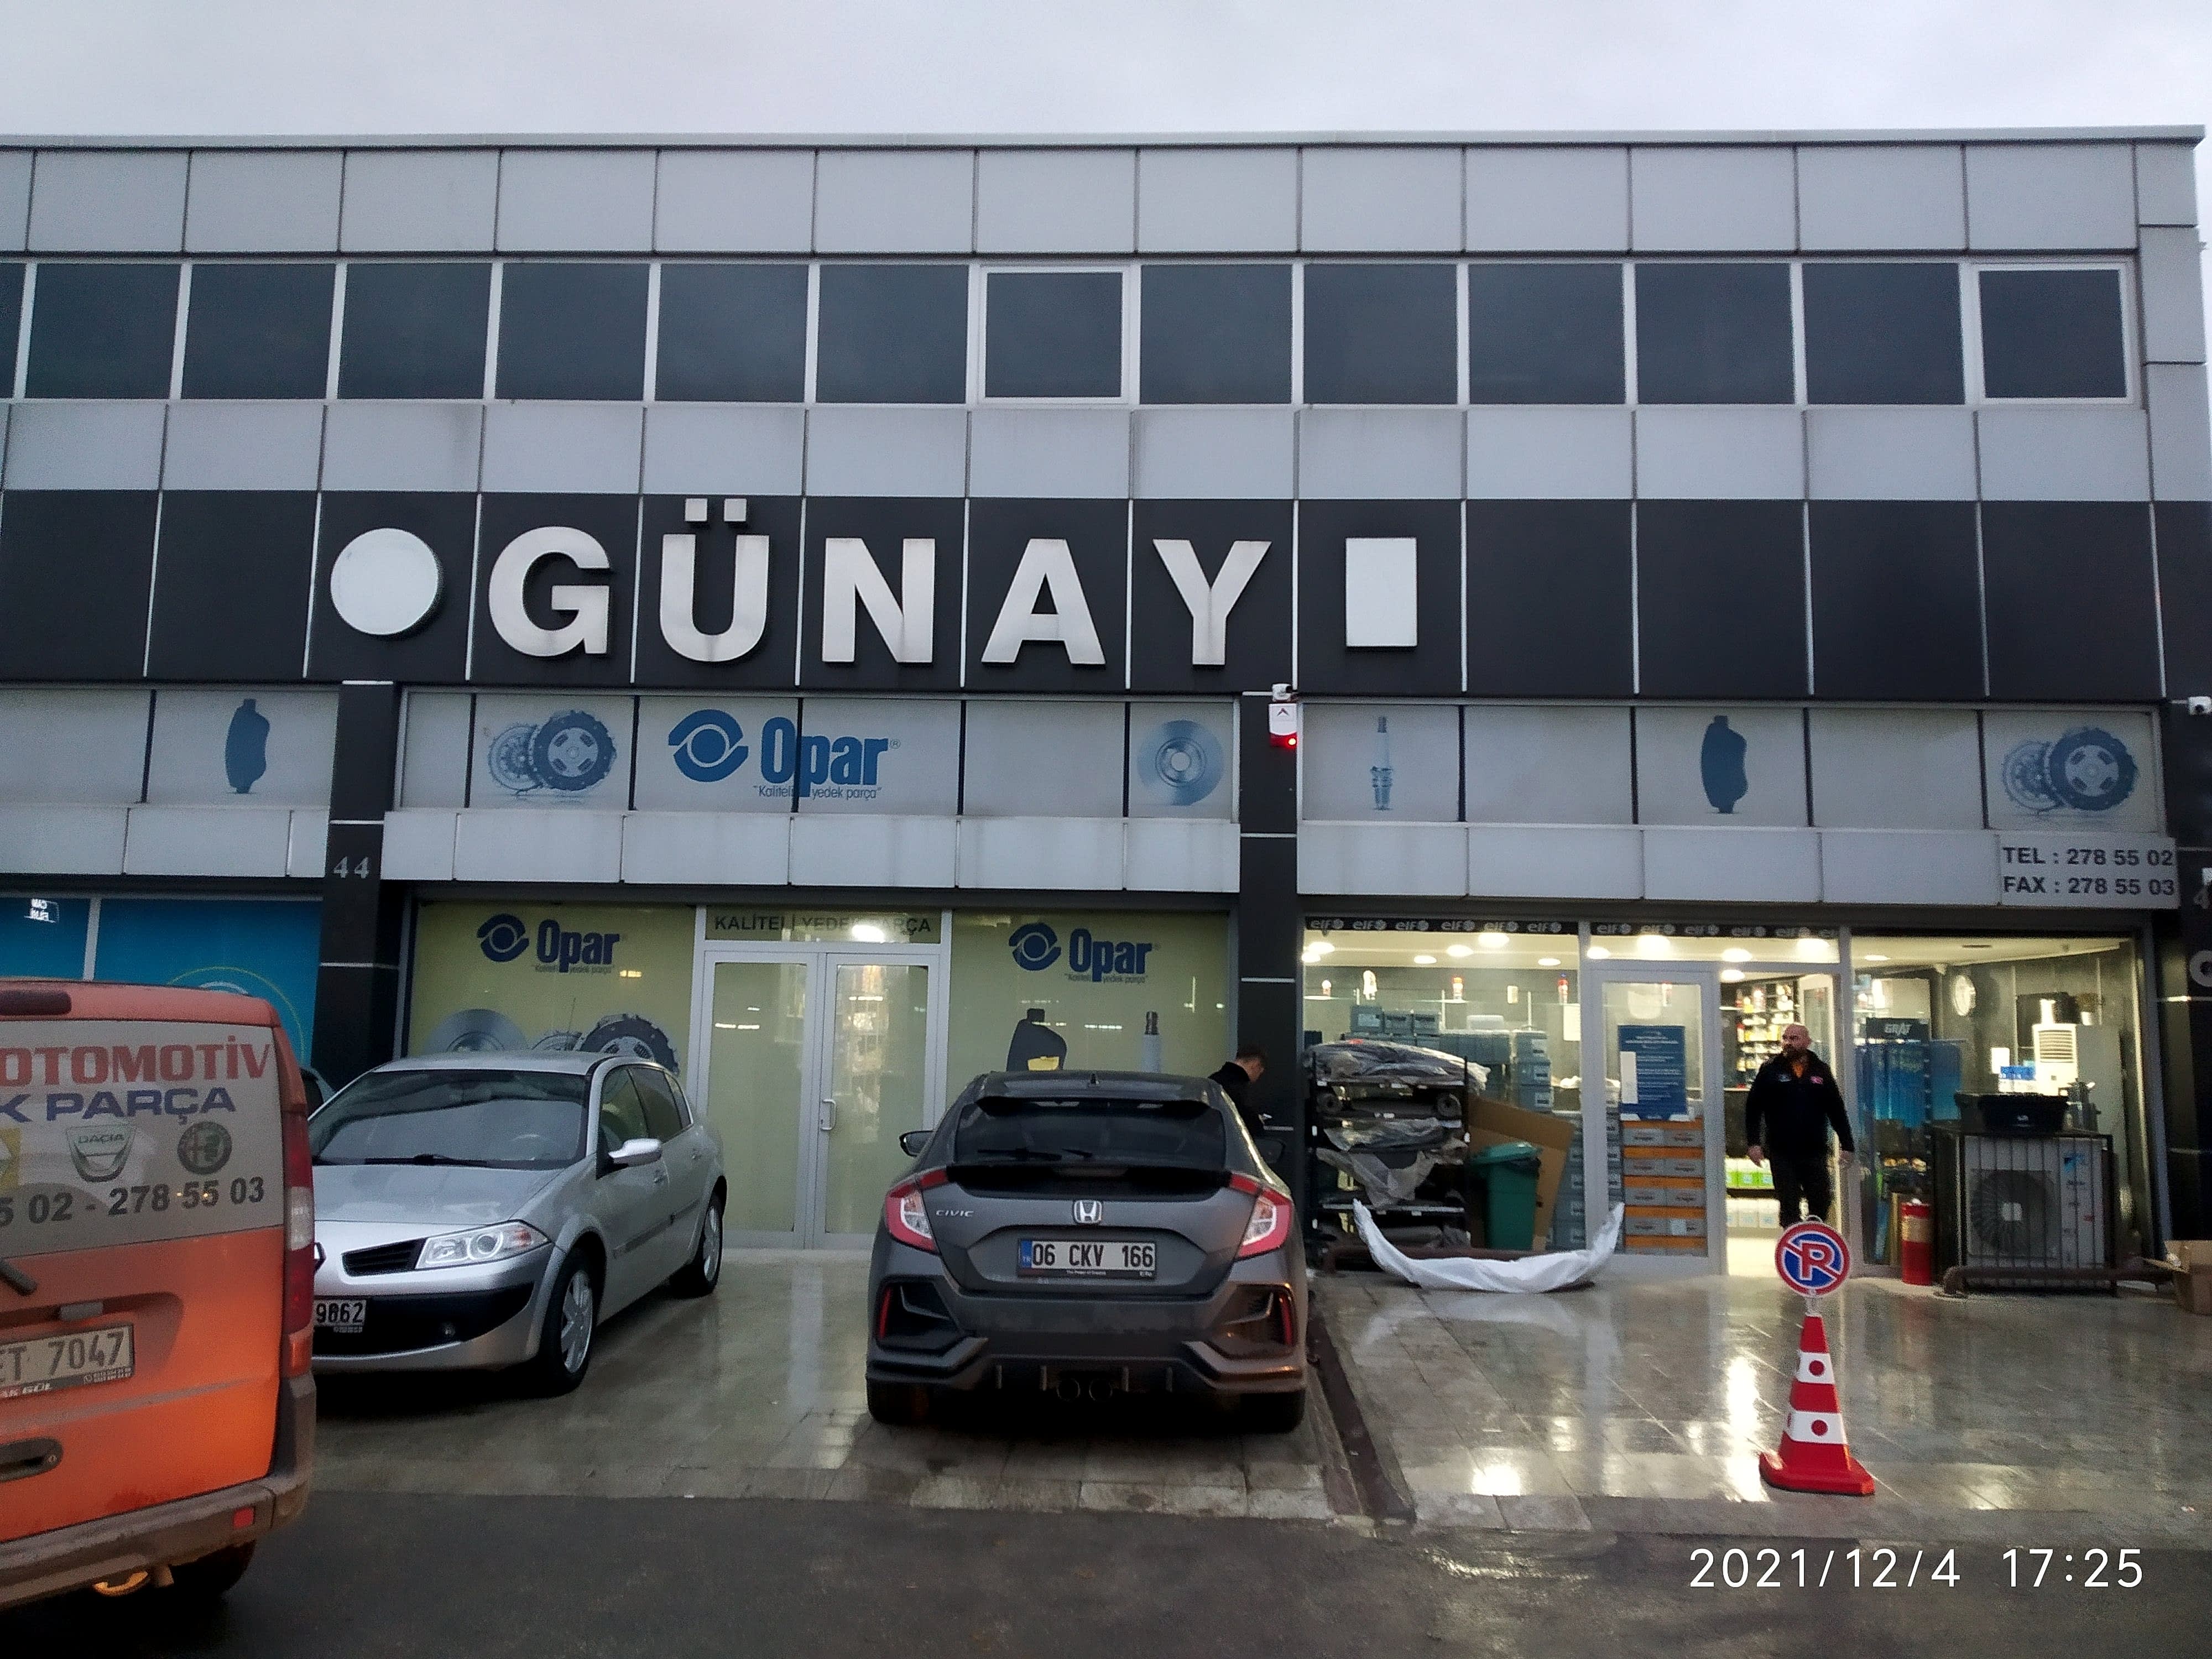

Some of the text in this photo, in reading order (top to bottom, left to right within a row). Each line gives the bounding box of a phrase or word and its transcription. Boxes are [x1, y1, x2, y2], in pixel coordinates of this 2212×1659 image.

[489, 498, 1272, 665] GÜNAY
[761, 717, 889, 797] Opar
[812, 786, 843, 800] yedek
[333, 856, 369, 878] 44
[2002, 847, 2046, 864] TEL
[2067, 848, 2106, 865] 278
[2114, 849, 2140, 866] 55
[2147, 849, 2173, 866] 02
[2003, 875, 2047, 894] FAX
[2068, 877, 2107, 894] 278
[2115, 878, 2141, 895] 55
[2148, 878, 2174, 896] 03
[536, 919, 620, 973] Opar
[1068, 927, 1152, 982] Opar
[46, 1087, 236, 1125] PARÇA
[28, 1192, 73, 1224] 02
[108, 1183, 170, 1217] 278
[181, 1179, 220, 1209] 55
[230, 1176, 264, 1204] 03
[1032, 1244, 1056, 1265] 06
[1069, 1244, 1104, 1267] CKV
[1122, 1245, 1154, 1267] 166
[48, 1331, 124, 1376] 7047
